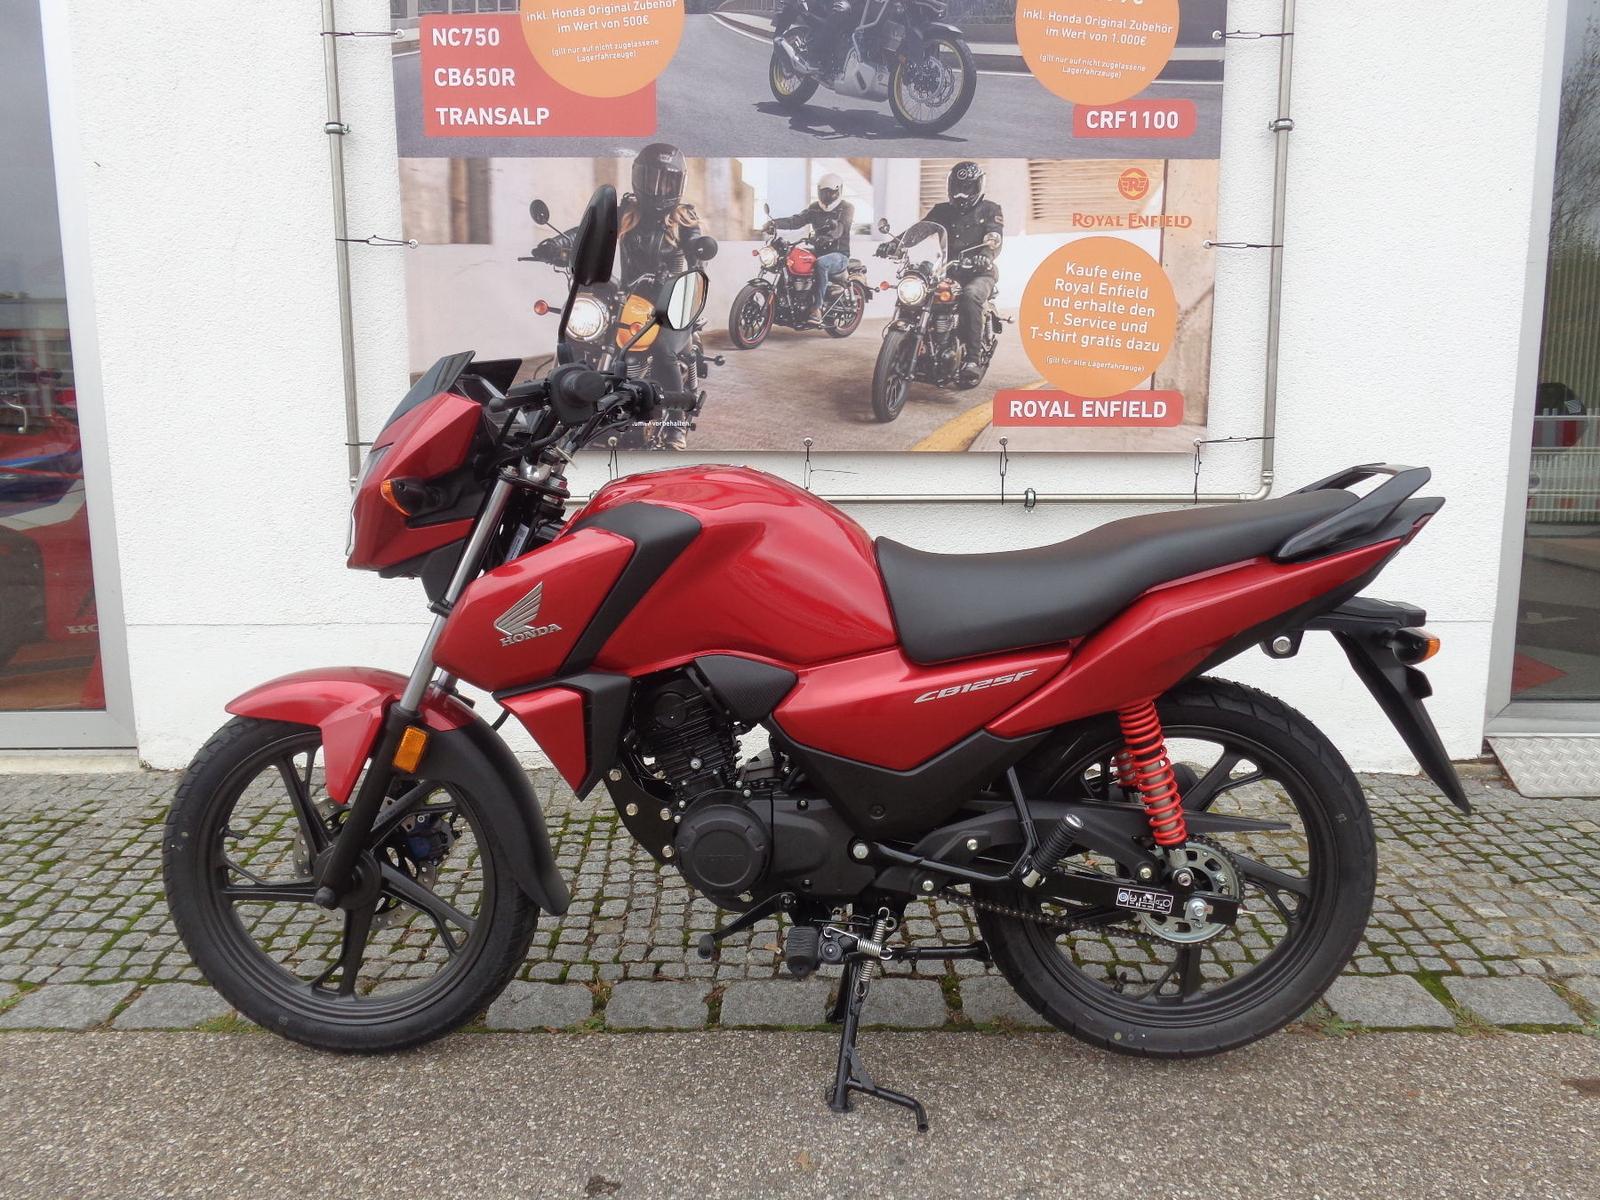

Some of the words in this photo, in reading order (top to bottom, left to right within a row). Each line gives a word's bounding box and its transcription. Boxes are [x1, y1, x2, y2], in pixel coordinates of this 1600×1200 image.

[526, 10, 548, 21] inkl.
[552, 8, 585, 20] Honda
[588, 1, 631, 16] Original
[557, 23, 571, 33] im
[572, 20, 598, 31] Wert
[600, 18, 620, 29] von
[623, 15, 649, 27] 500€
[1023, 9, 1045, 20] inkl.
[1048, 11, 1081, 24] Honda
[1085, 14, 1126, 29] Original
[1129, 19, 1173, 34] Zubehör
[432, 28, 500, 46] NC750
[1045, 26, 1059, 36] im
[1062, 28, 1087, 39] Wert
[1089, 32, 1107, 42] von
[1110, 33, 1147, 46] 1.000€
[567, 46, 580, 54] nur
[434, 67, 516, 87] CB650R
[435, 107, 550, 125] TRANSALP
[1086, 110, 1179, 130] CRF1100
[1072, 212, 1123, 228] ROYAL
[1128, 212, 1193, 229] ENFIELD
[1065, 261, 1108, 278] Kaufe
[1111, 269, 1142, 282] eine
[1055, 278, 1094, 295] Royal
[1098, 282, 1148, 300] Enfield
[1043, 296, 1070, 309] und
[1074, 298, 1125, 314] erhalte
[1129, 303, 1156, 317] den
[1048, 311, 1060, 325] 1.
[1063, 313, 1117, 330] Service
[1121, 321, 1148, 334] und
[1030, 326, 1077, 344] T-shirt
[1081, 334, 1122, 348] gratis
[1126, 337, 1160, 353] dazu
[1073, 359, 1087, 367] alle
[1010, 400, 1076, 418] ROYAL
[1082, 400, 1167, 419] ENFIELD
[499, 623, 563, 647] HONDA
[914, 668, 1038, 704] CB125F
